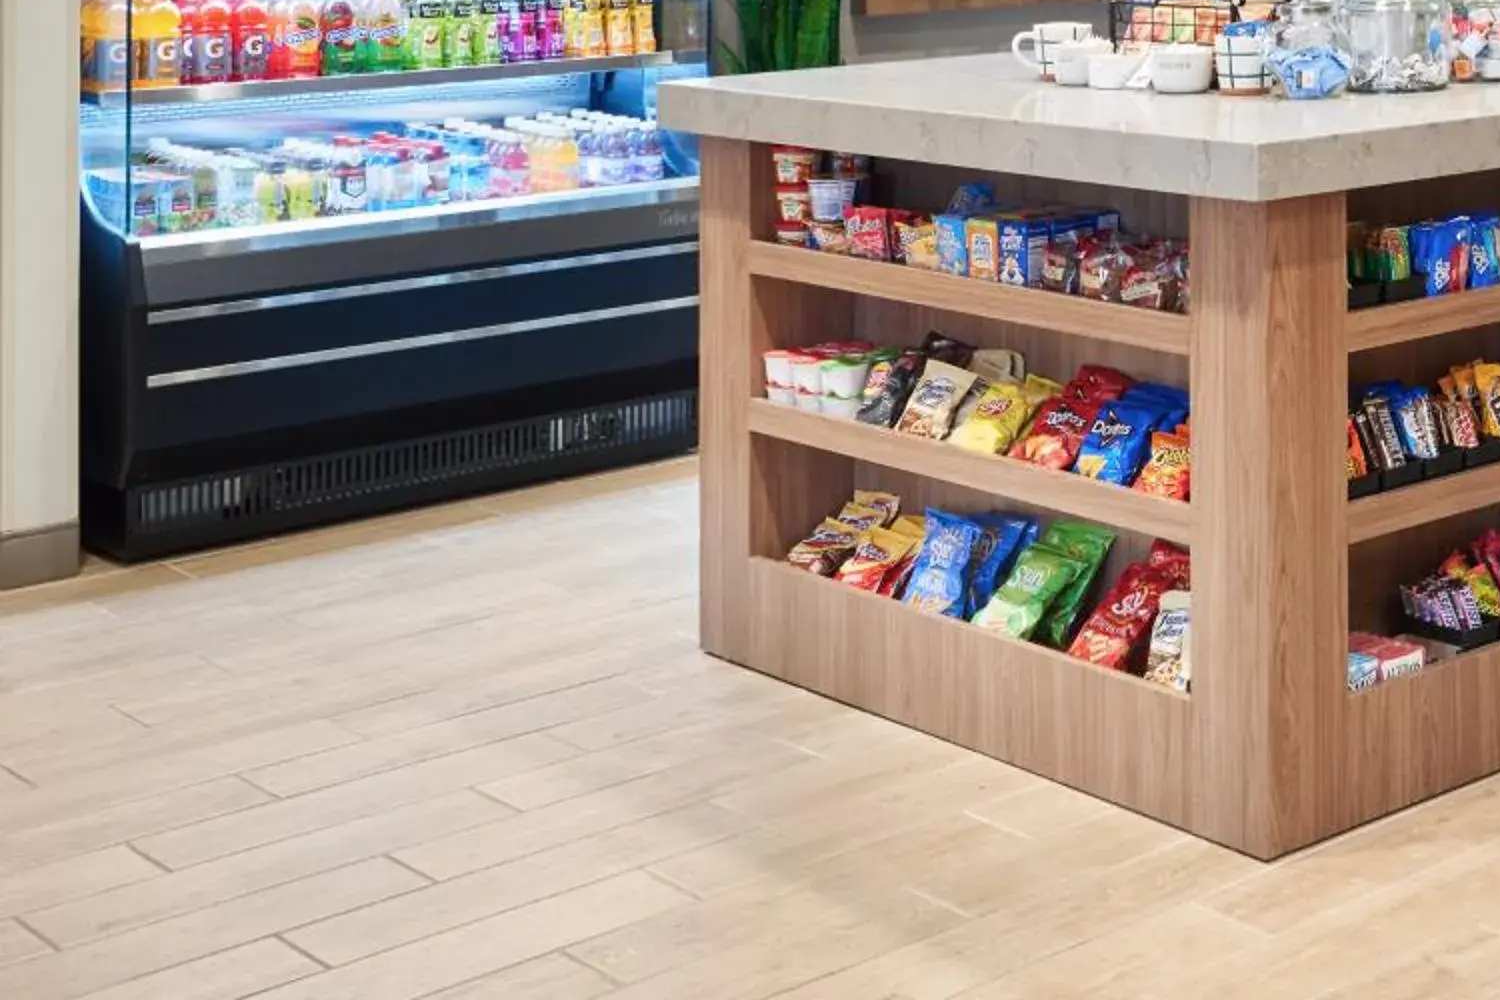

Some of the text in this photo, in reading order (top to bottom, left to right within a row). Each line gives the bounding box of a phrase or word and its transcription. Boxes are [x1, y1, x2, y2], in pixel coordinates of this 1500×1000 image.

[157, 40, 176, 62] G
[206, 38, 224, 59] G
[246, 35, 263, 56] G
[1091, 419, 1133, 438] Doritos
